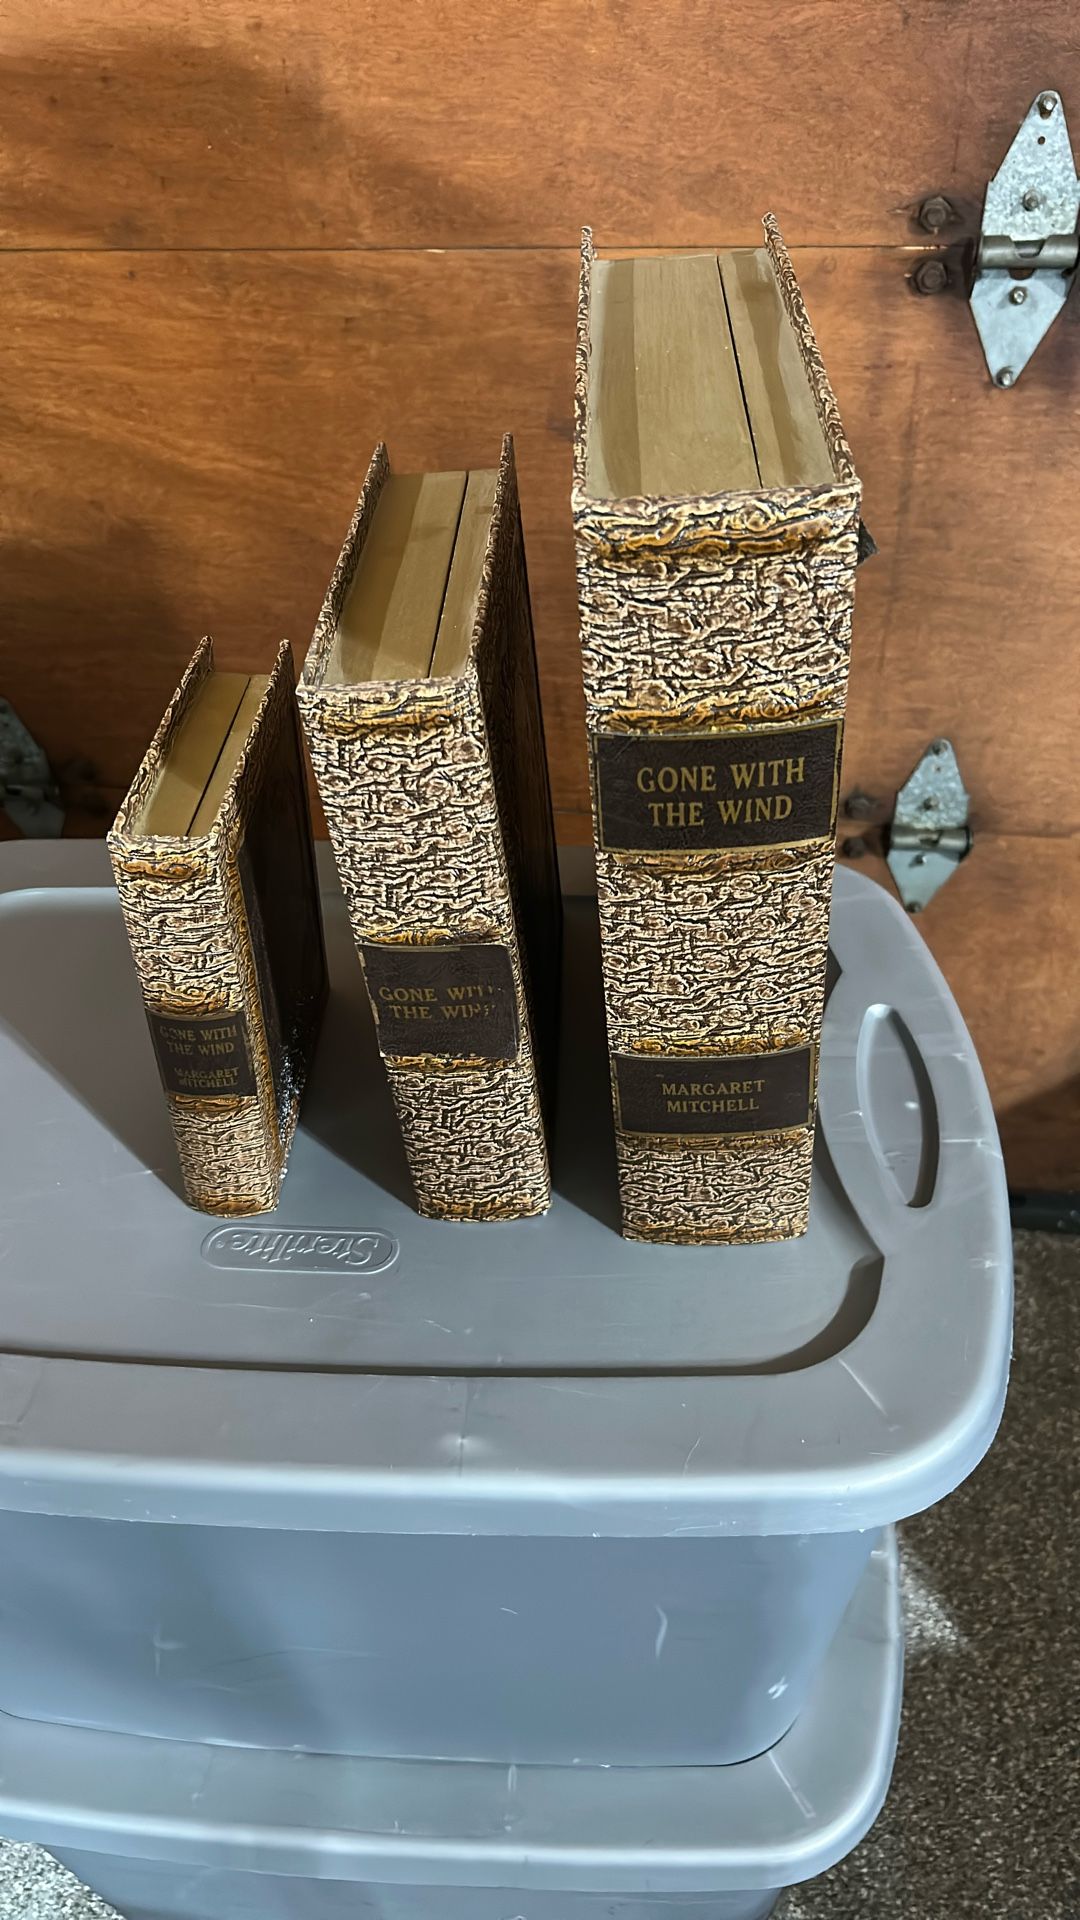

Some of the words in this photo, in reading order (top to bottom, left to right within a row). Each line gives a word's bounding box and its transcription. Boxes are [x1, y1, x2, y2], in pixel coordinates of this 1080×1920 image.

[636, 766, 717, 793] GONE
[730, 756, 805, 789] WITH
[648, 802, 704, 827] THE
[717, 795, 793, 825] WIND
[378, 986, 438, 1002] GONE
[389, 1004, 432, 1019] THE
[200, 1024, 237, 1041] WITH
[166, 1041, 193, 1055] THE
[198, 1041, 235, 1056] WIND
[662, 1080, 766, 1096] MARGARET
[667, 1098, 760, 1113] MITCHELL
